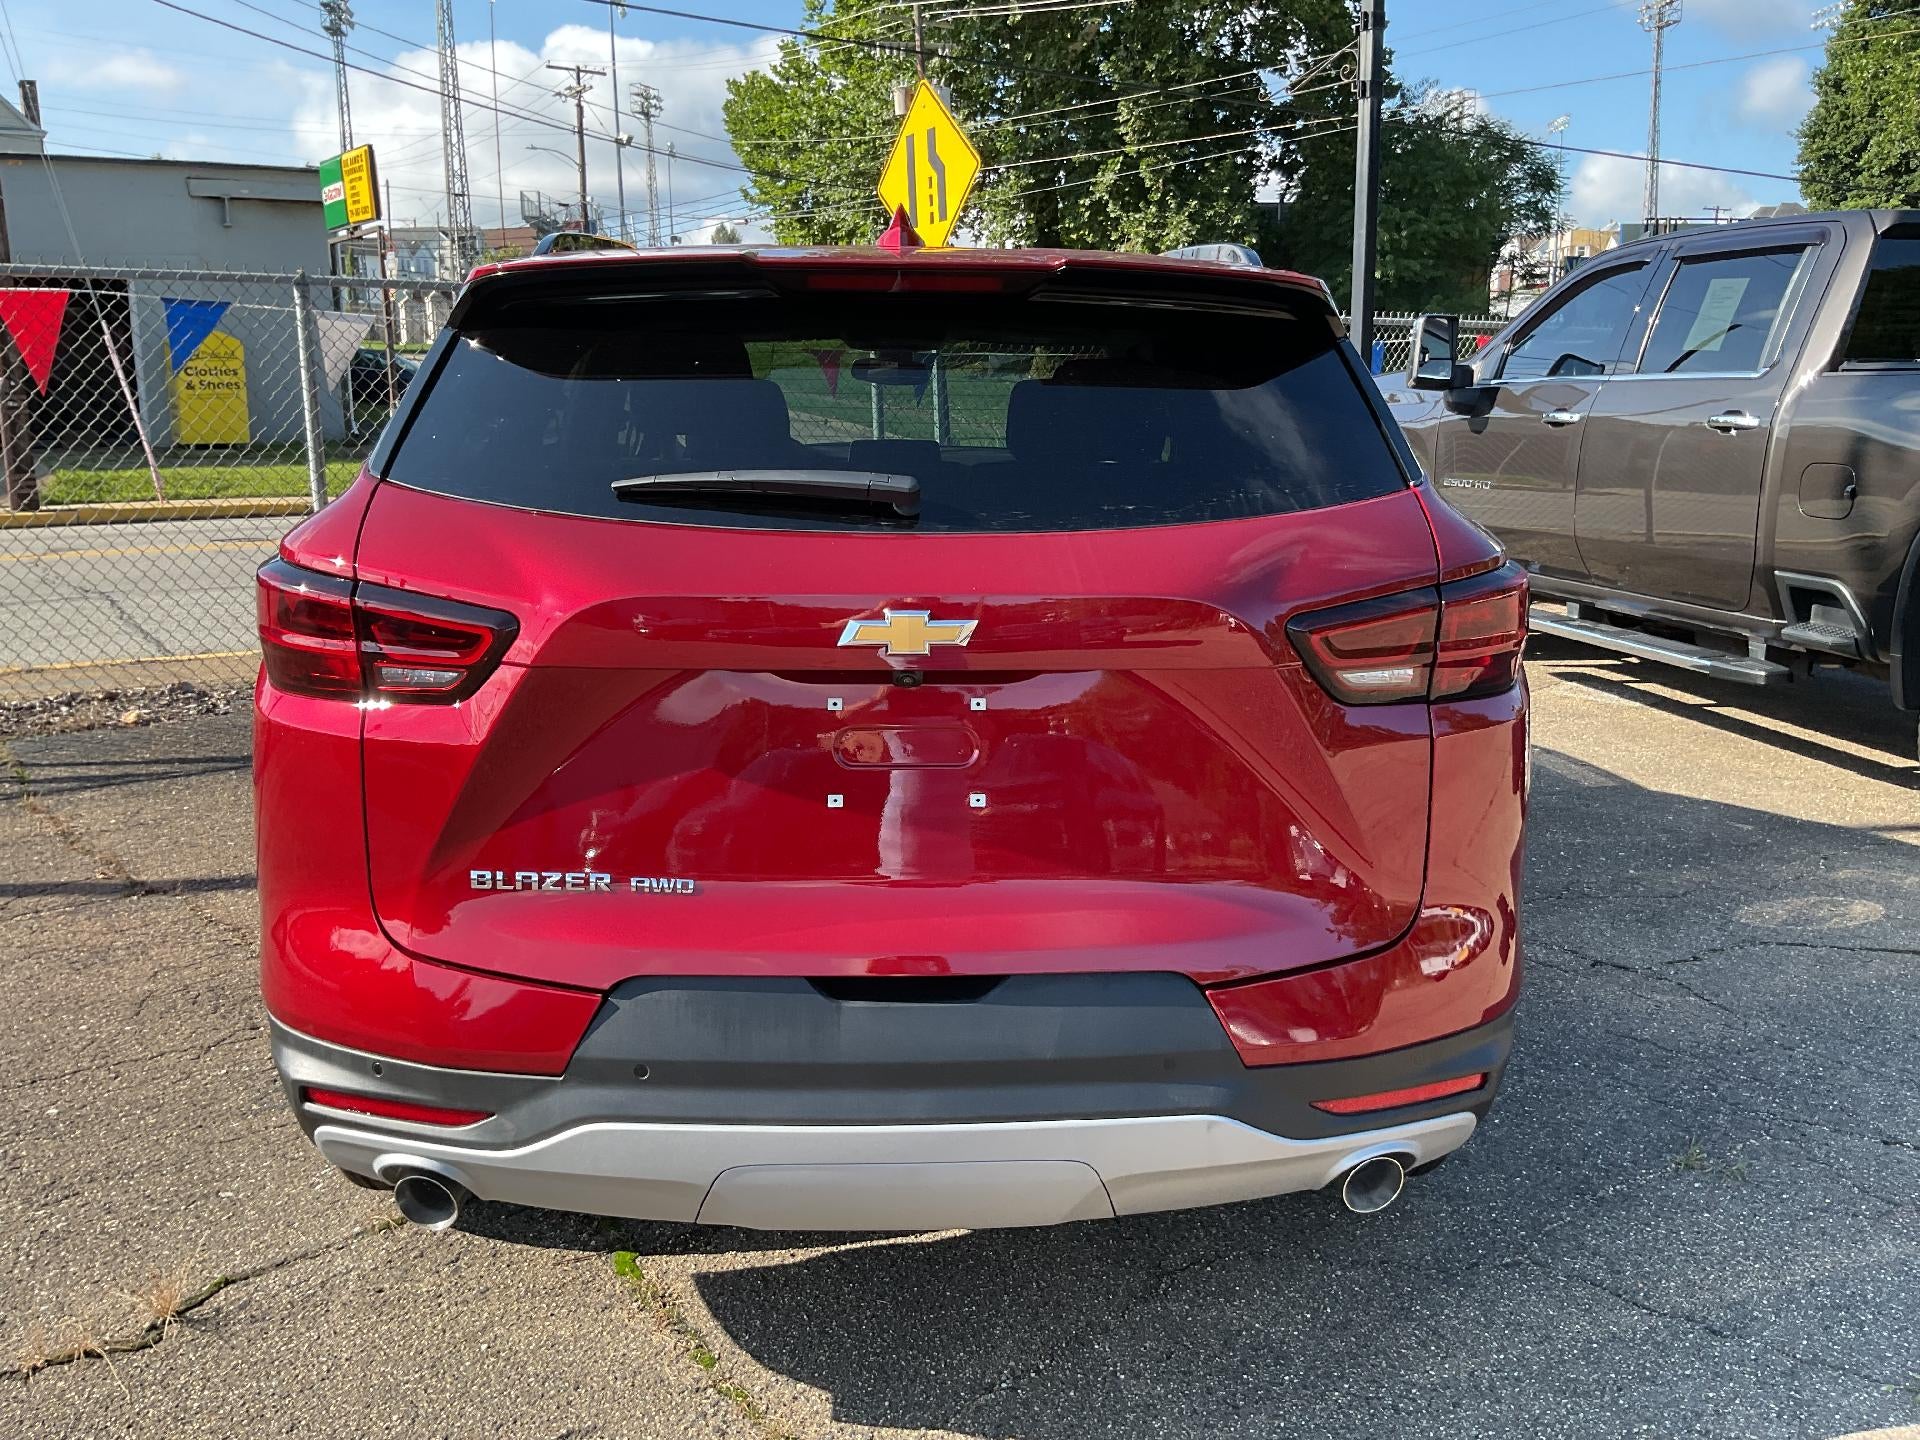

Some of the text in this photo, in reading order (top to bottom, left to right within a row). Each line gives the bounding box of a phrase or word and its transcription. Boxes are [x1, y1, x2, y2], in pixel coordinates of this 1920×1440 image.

[184, 366, 239, 377] Clothes
[186, 380, 241, 390] & Shoes
[1443, 478, 1491, 489] 2500 HD
[470, 869, 695, 894] BLAZER AWD
